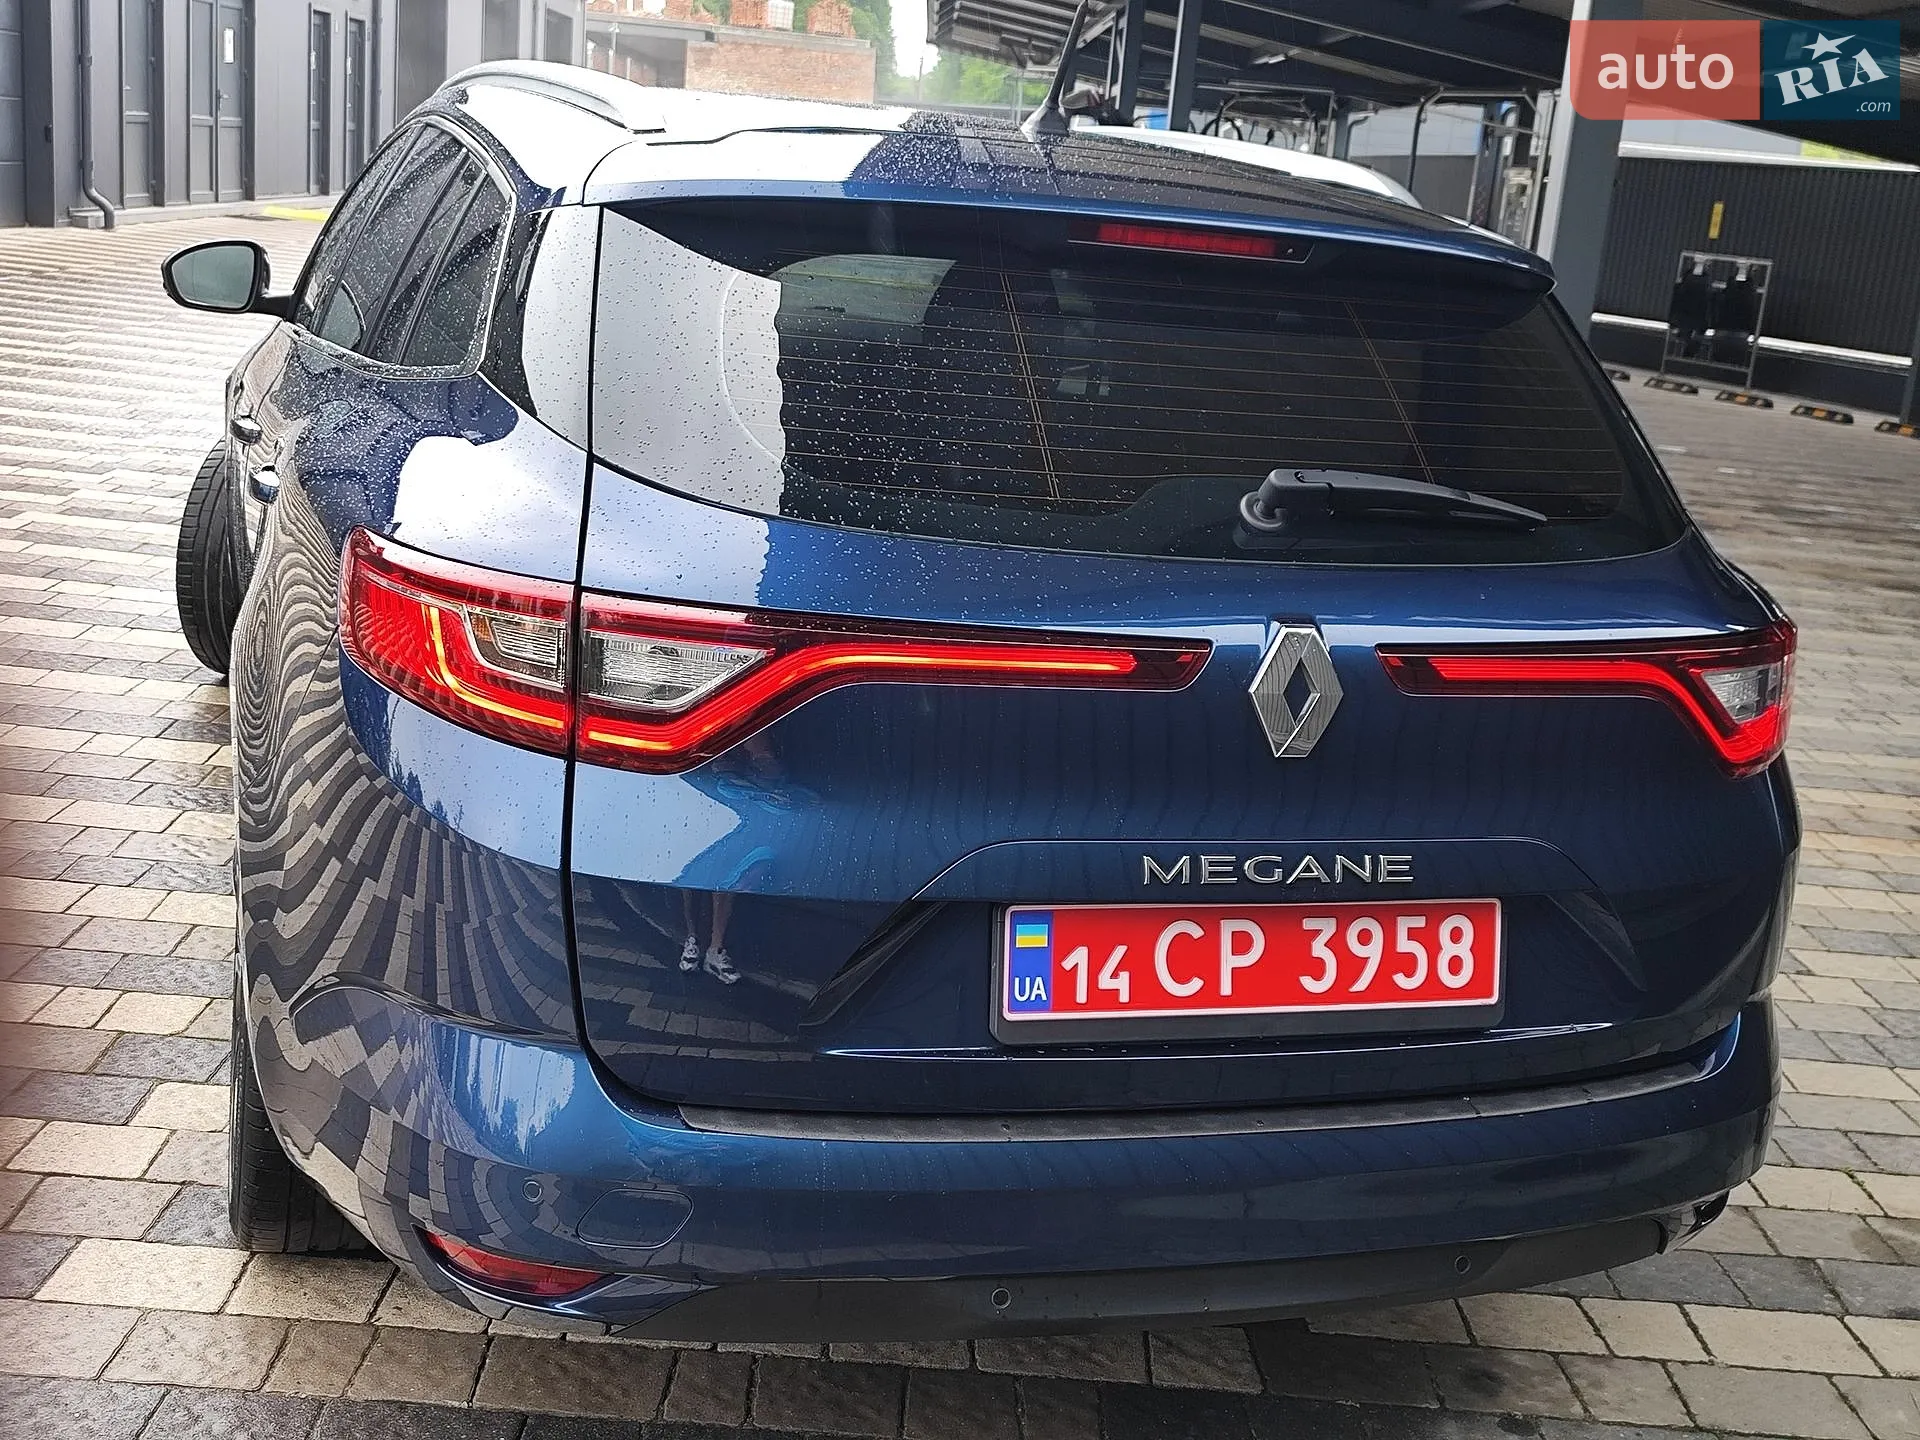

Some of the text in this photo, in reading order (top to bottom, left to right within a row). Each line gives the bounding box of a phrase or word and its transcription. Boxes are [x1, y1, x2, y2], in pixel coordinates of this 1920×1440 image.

[1143, 854, 1415, 885] MEGANE
[1061, 913, 1476, 1004] 14 CP 3958
[1014, 977, 1048, 1002] UA
